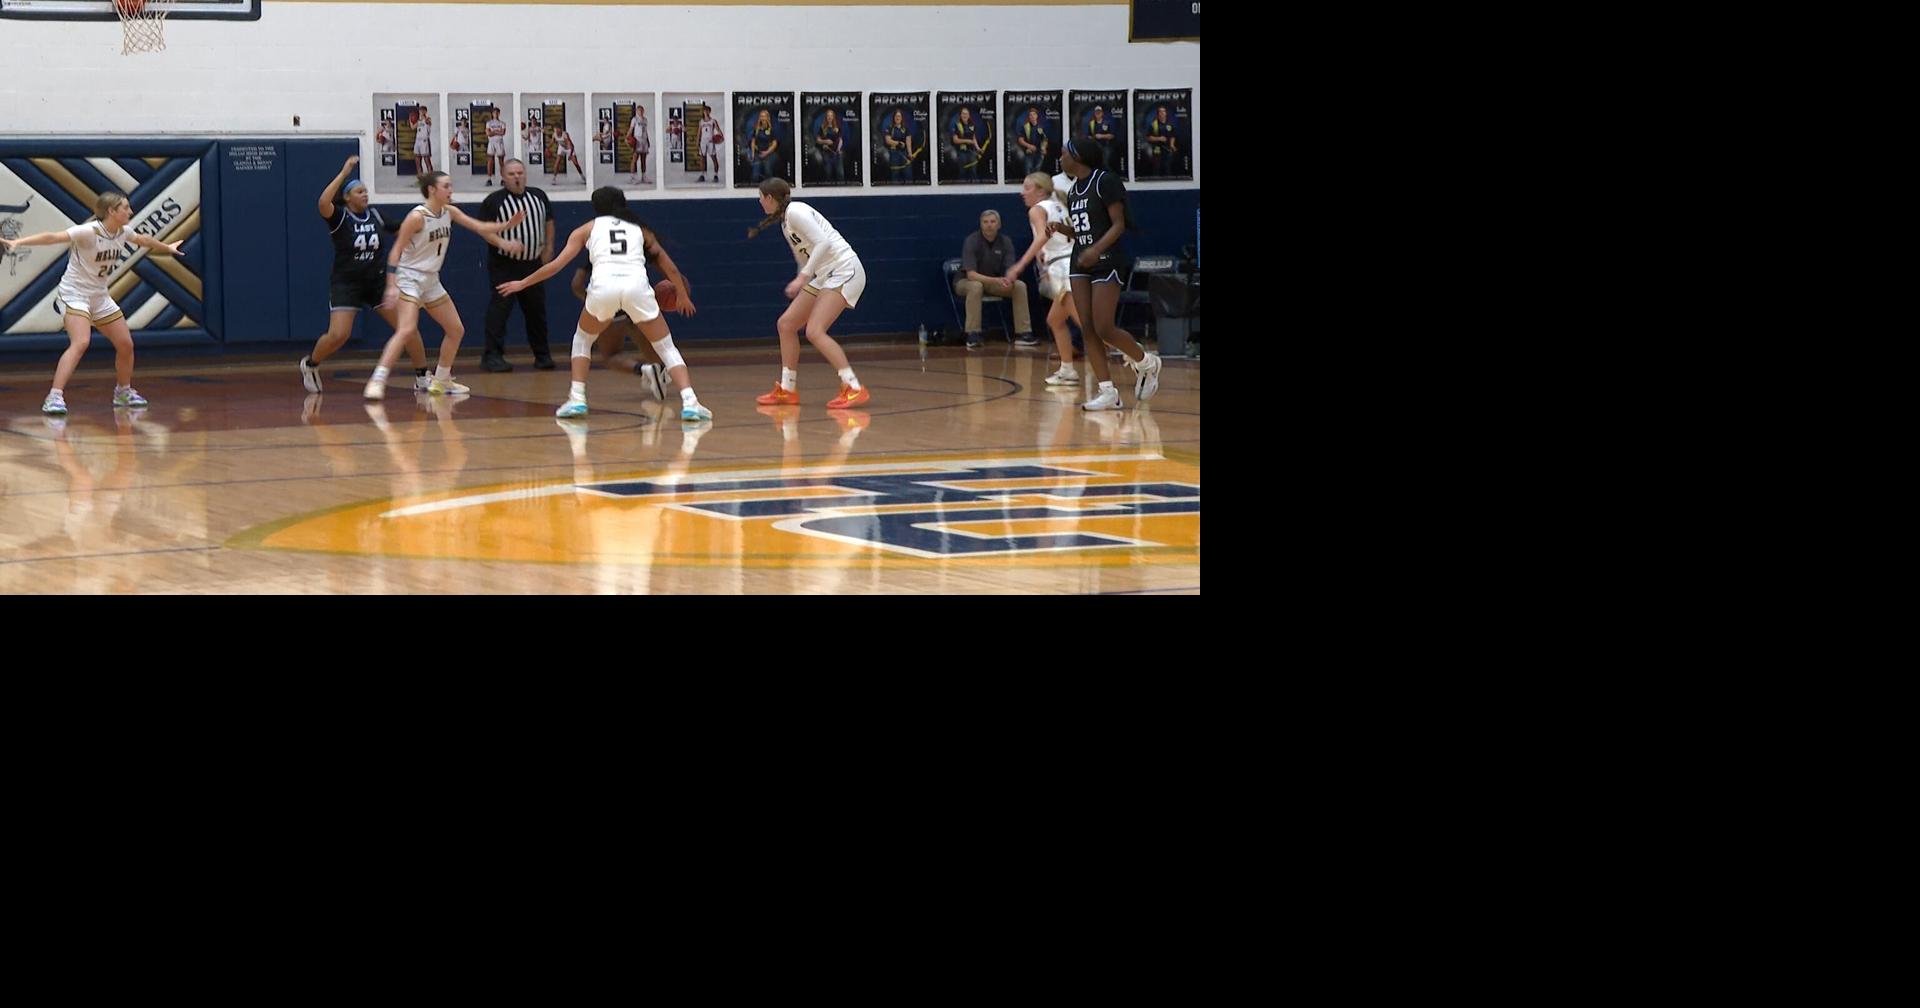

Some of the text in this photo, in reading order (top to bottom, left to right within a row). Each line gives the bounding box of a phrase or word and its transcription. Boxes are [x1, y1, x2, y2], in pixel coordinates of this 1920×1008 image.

[738, 95, 789, 105] ARCHERY
[805, 95, 856, 105] ARCHERY
[874, 95, 925, 105] ARCHERY
[941, 95, 991, 104] ARCHERY
[1008, 94, 1058, 104] ARCHERY
[1074, 93, 1123, 102] ARCHERY
[1137, 92, 1187, 101] ARCHERY
[383, 110, 393, 119] 14
[456, 110, 468, 120] 35
[529, 109, 540, 120] 20
[1070, 198, 1089, 211] LADY
[354, 223, 376, 232] LADY
[1071, 212, 1091, 233] 23
[354, 233, 380, 250] 44
[609, 229, 627, 256] 5
[437, 243, 442, 256] 1
